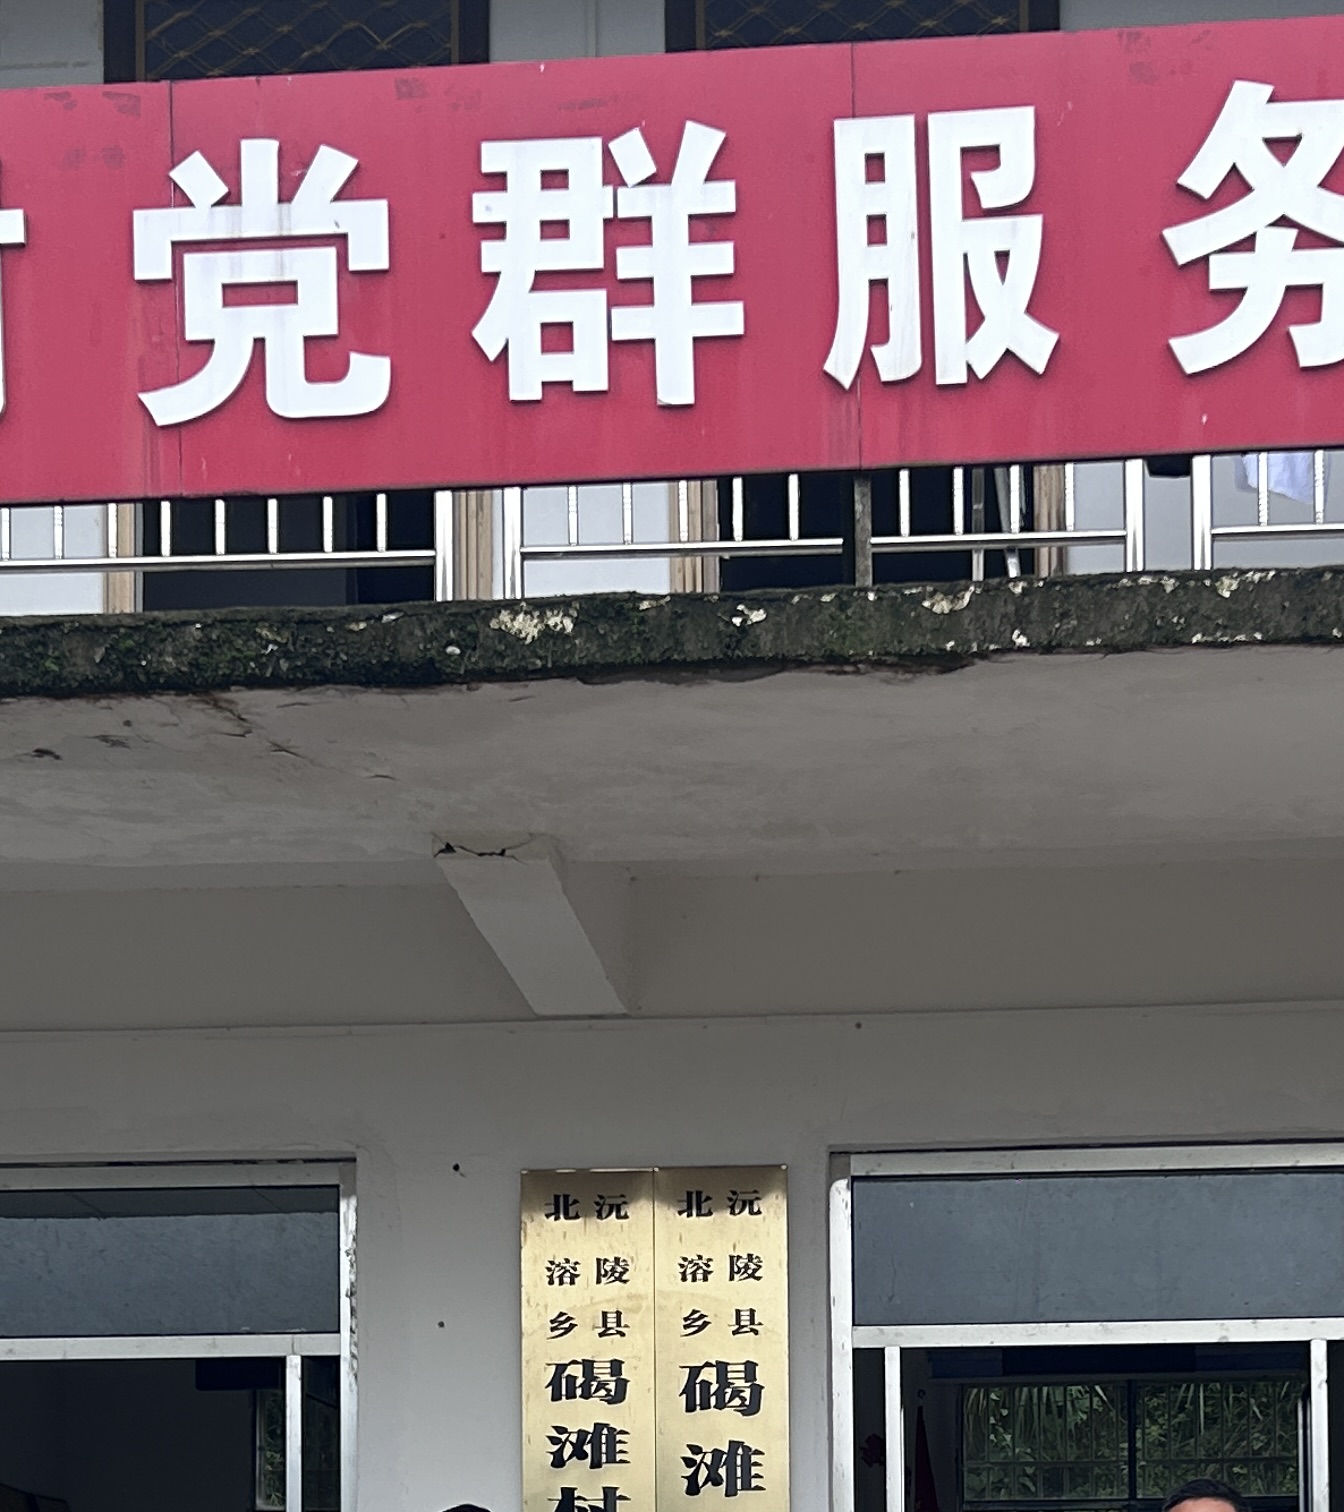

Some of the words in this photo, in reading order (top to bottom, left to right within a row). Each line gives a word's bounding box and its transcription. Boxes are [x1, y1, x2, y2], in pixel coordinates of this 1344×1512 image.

[545, 1194, 582, 1340] 北溶乡
[593, 1194, 631, 1338] 沅陵县
[677, 1190, 714, 1337] 北溶乡
[726, 1189, 765, 1336] 沅陵县
